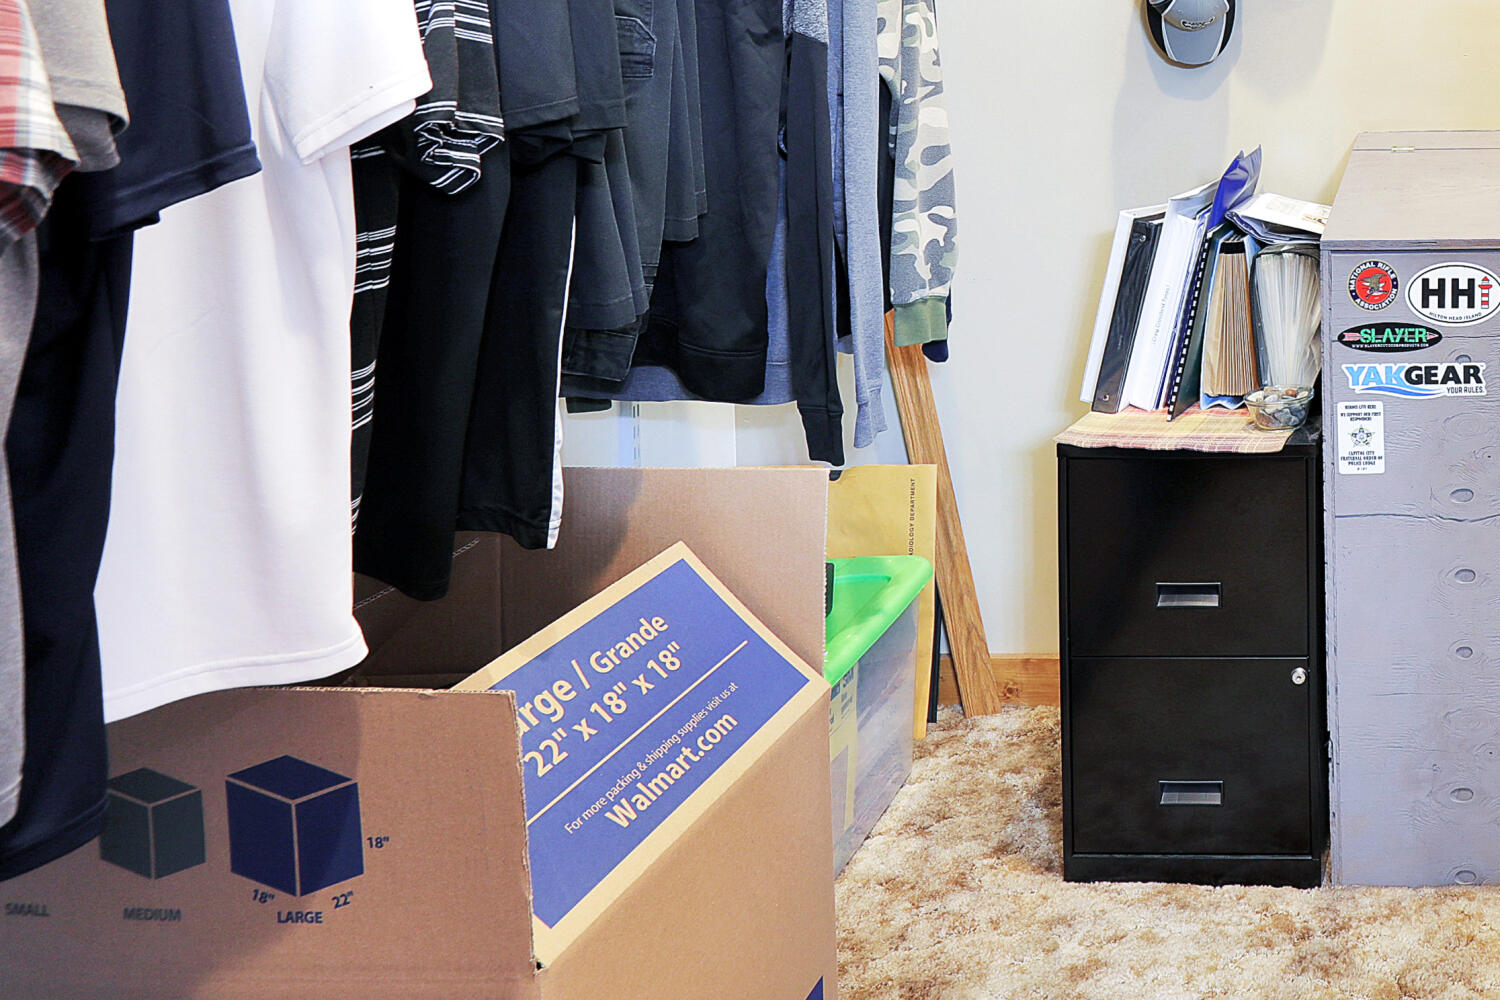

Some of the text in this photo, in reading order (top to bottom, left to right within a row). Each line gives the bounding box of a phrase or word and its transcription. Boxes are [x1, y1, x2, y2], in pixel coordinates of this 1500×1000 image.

[1349, 261, 1397, 291] NATIONAL RIFLE
[1355, 288, 1398, 310] ASSOCIATION
[1428, 311, 1448, 321] HILTON
[1464, 311, 1482, 320] ISLAND
[1360, 328, 1428, 343] SLAYER
[1344, 364, 1484, 387] YAKGEAR
[1446, 386, 1462, 394] YOUR
[589, 616, 669, 673] Grande
[522, 641, 681, 778] 22" x 18" x 18"
[564, 681, 739, 834] For more packing & shipping supplies visit us at
[604, 713, 739, 828] Walmart.com
[366, 836, 390, 849] 18"
[251, 888, 275, 904] 18"
[332, 890, 354, 910] 22"
[5, 903, 50, 918] SMALL
[123, 907, 182, 922] MEDIUM
[277, 910, 323, 924] LARGE
